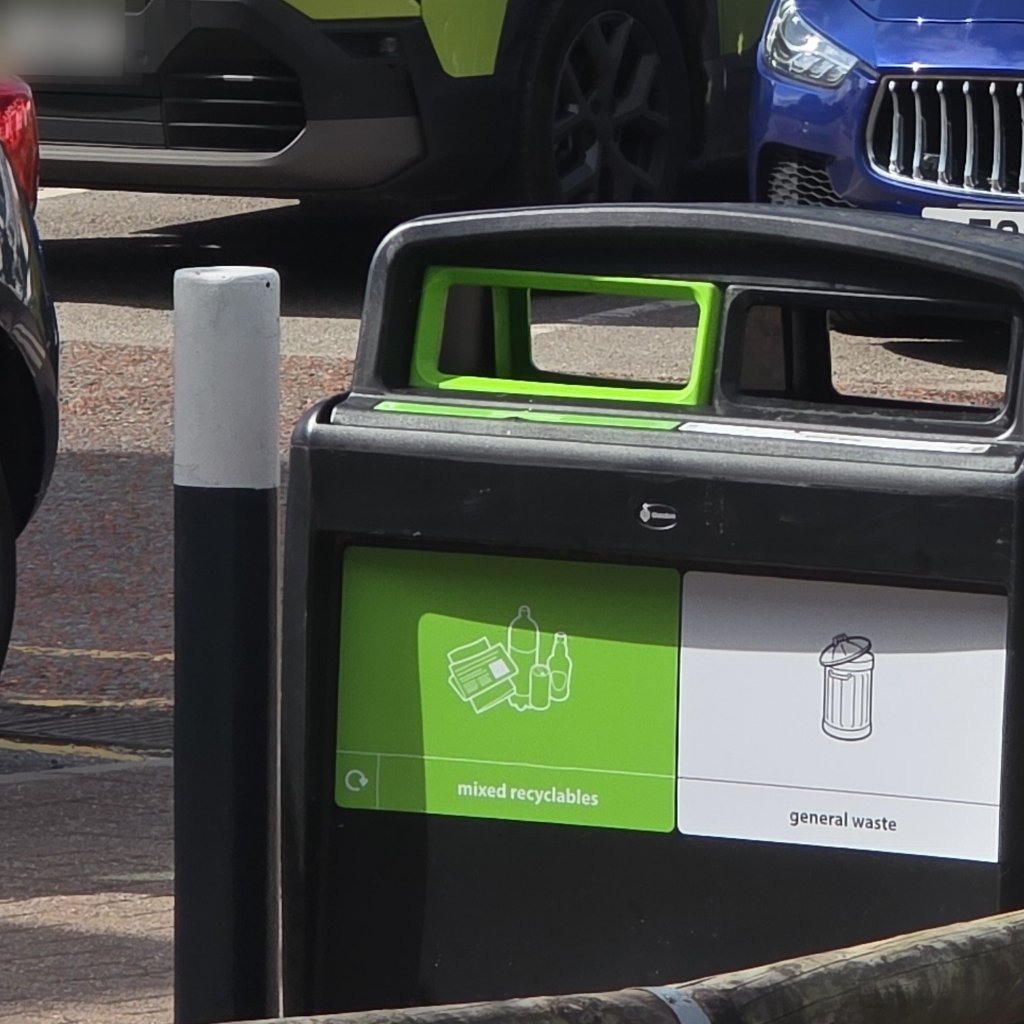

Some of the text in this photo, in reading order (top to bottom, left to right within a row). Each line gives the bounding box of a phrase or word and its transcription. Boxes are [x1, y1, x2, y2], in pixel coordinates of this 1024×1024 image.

[457, 781, 599, 806] mixed recyclables
[789, 810, 897, 831] general waste
